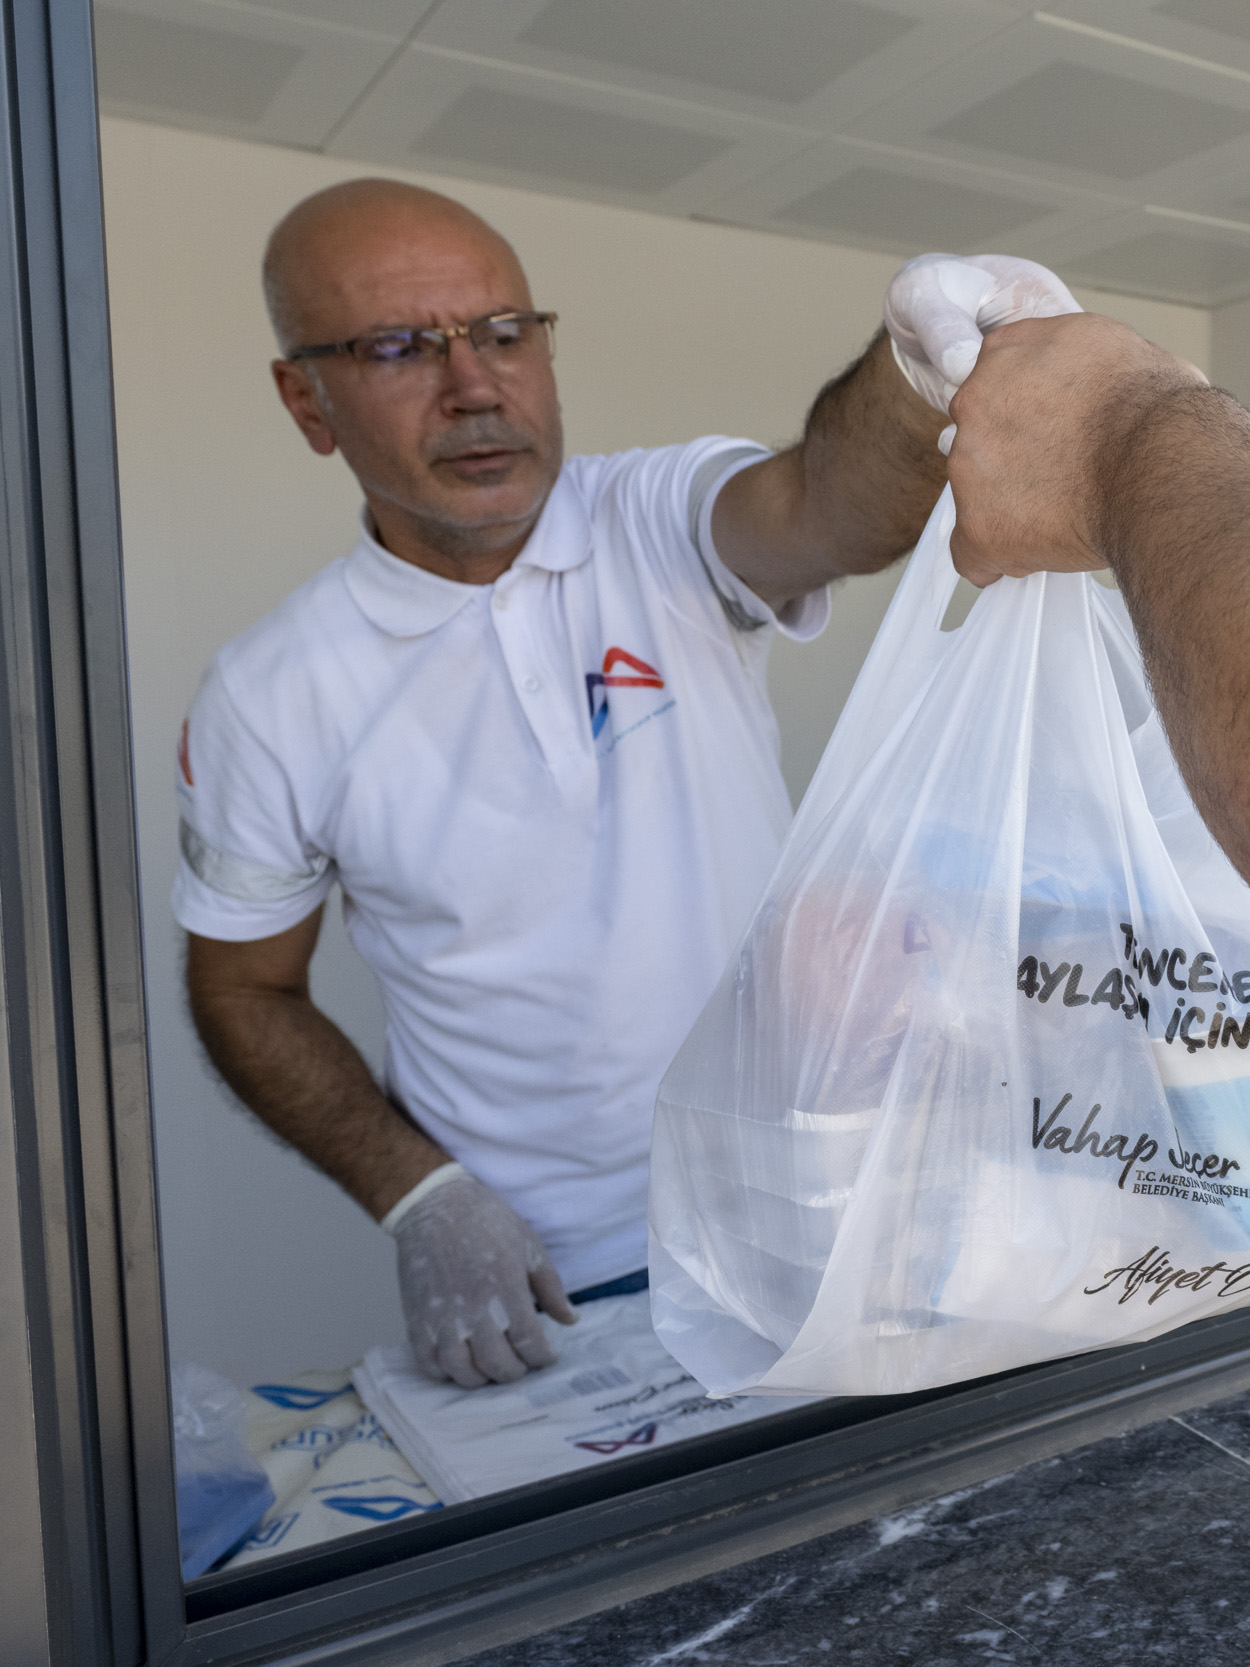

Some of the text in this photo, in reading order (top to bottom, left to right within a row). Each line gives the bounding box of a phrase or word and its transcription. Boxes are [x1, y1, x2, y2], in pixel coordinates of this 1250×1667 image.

[1017, 955, 1150, 1033] AYLAŞ
[1032, 1093, 1159, 1189] Vahap
[1132, 1183, 1226, 1208] BELEDİYE BAŞKANI
[1135, 1169, 1157, 1182] T.C.
[1159, 1172, 1200, 1189] MERSİN
[1083, 1245, 1230, 1306] Afiyet
